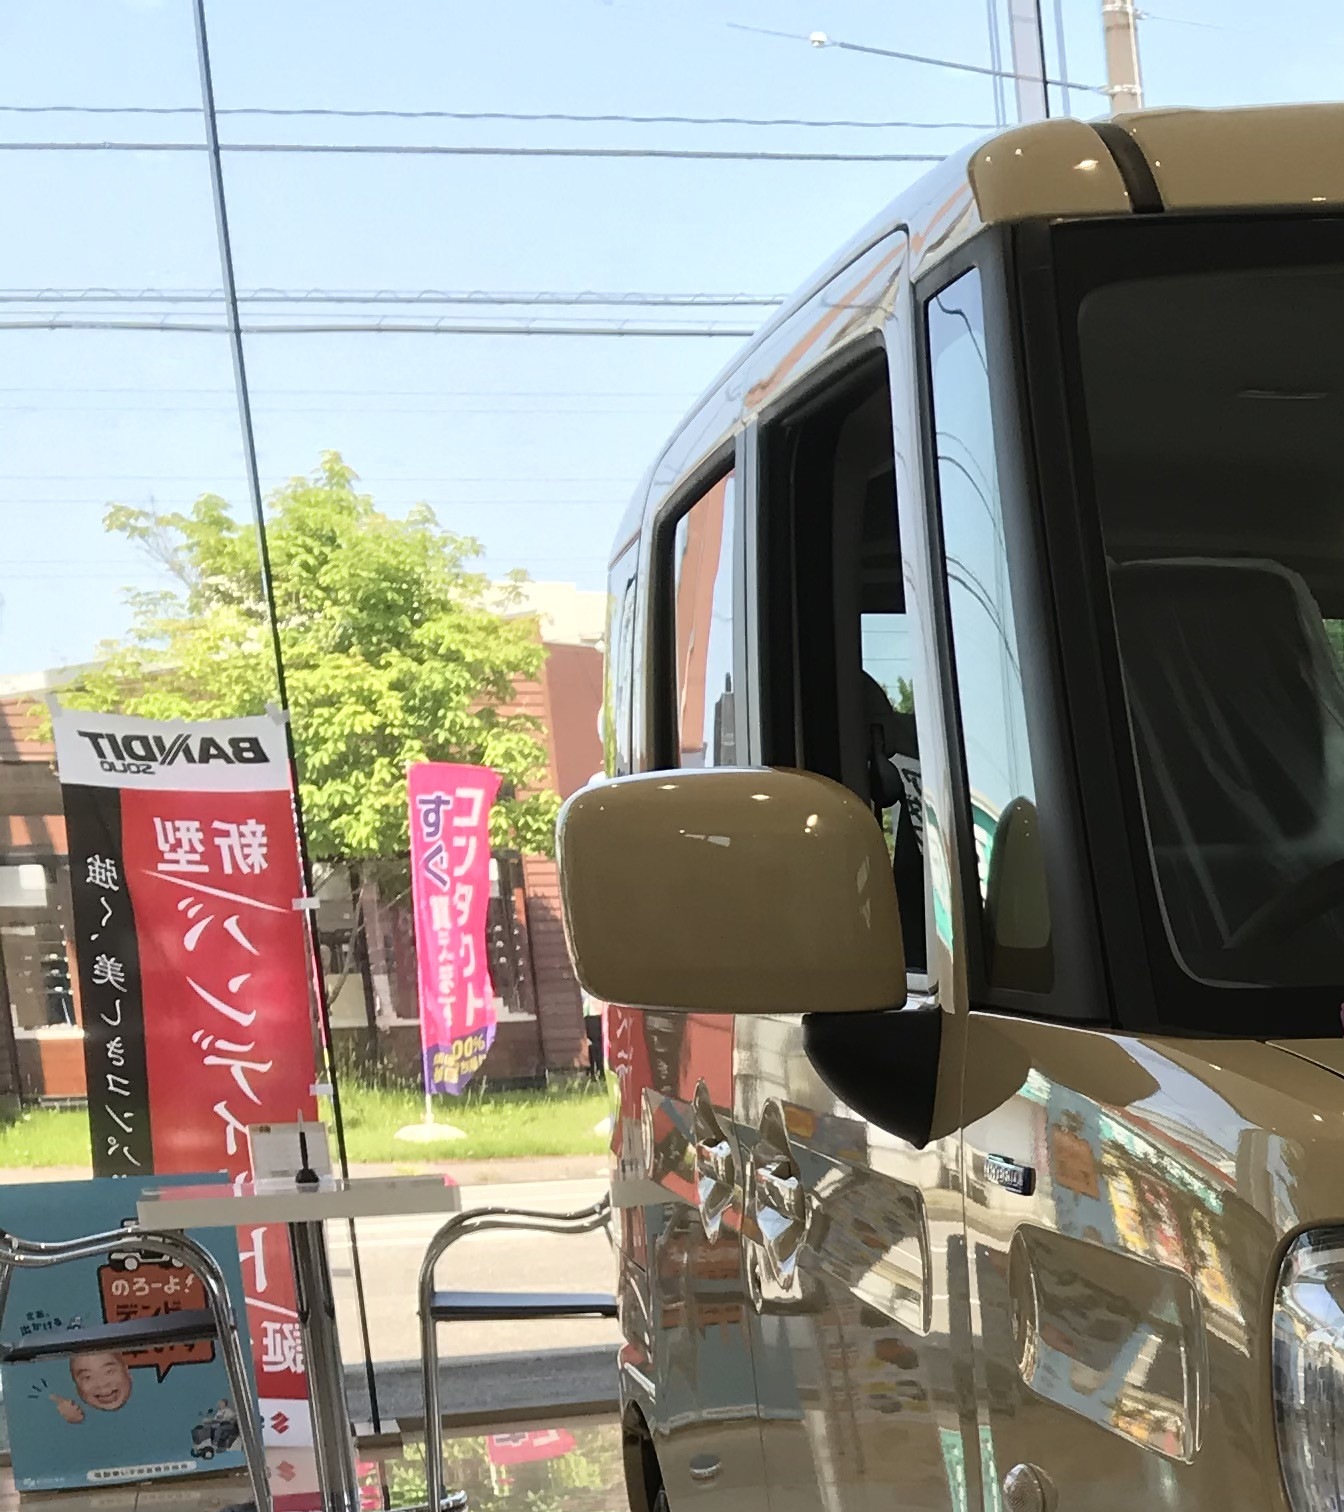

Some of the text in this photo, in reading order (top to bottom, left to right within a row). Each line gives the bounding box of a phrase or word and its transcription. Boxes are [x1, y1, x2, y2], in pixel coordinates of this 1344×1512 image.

[452, 786, 486, 1028] コンタクト
